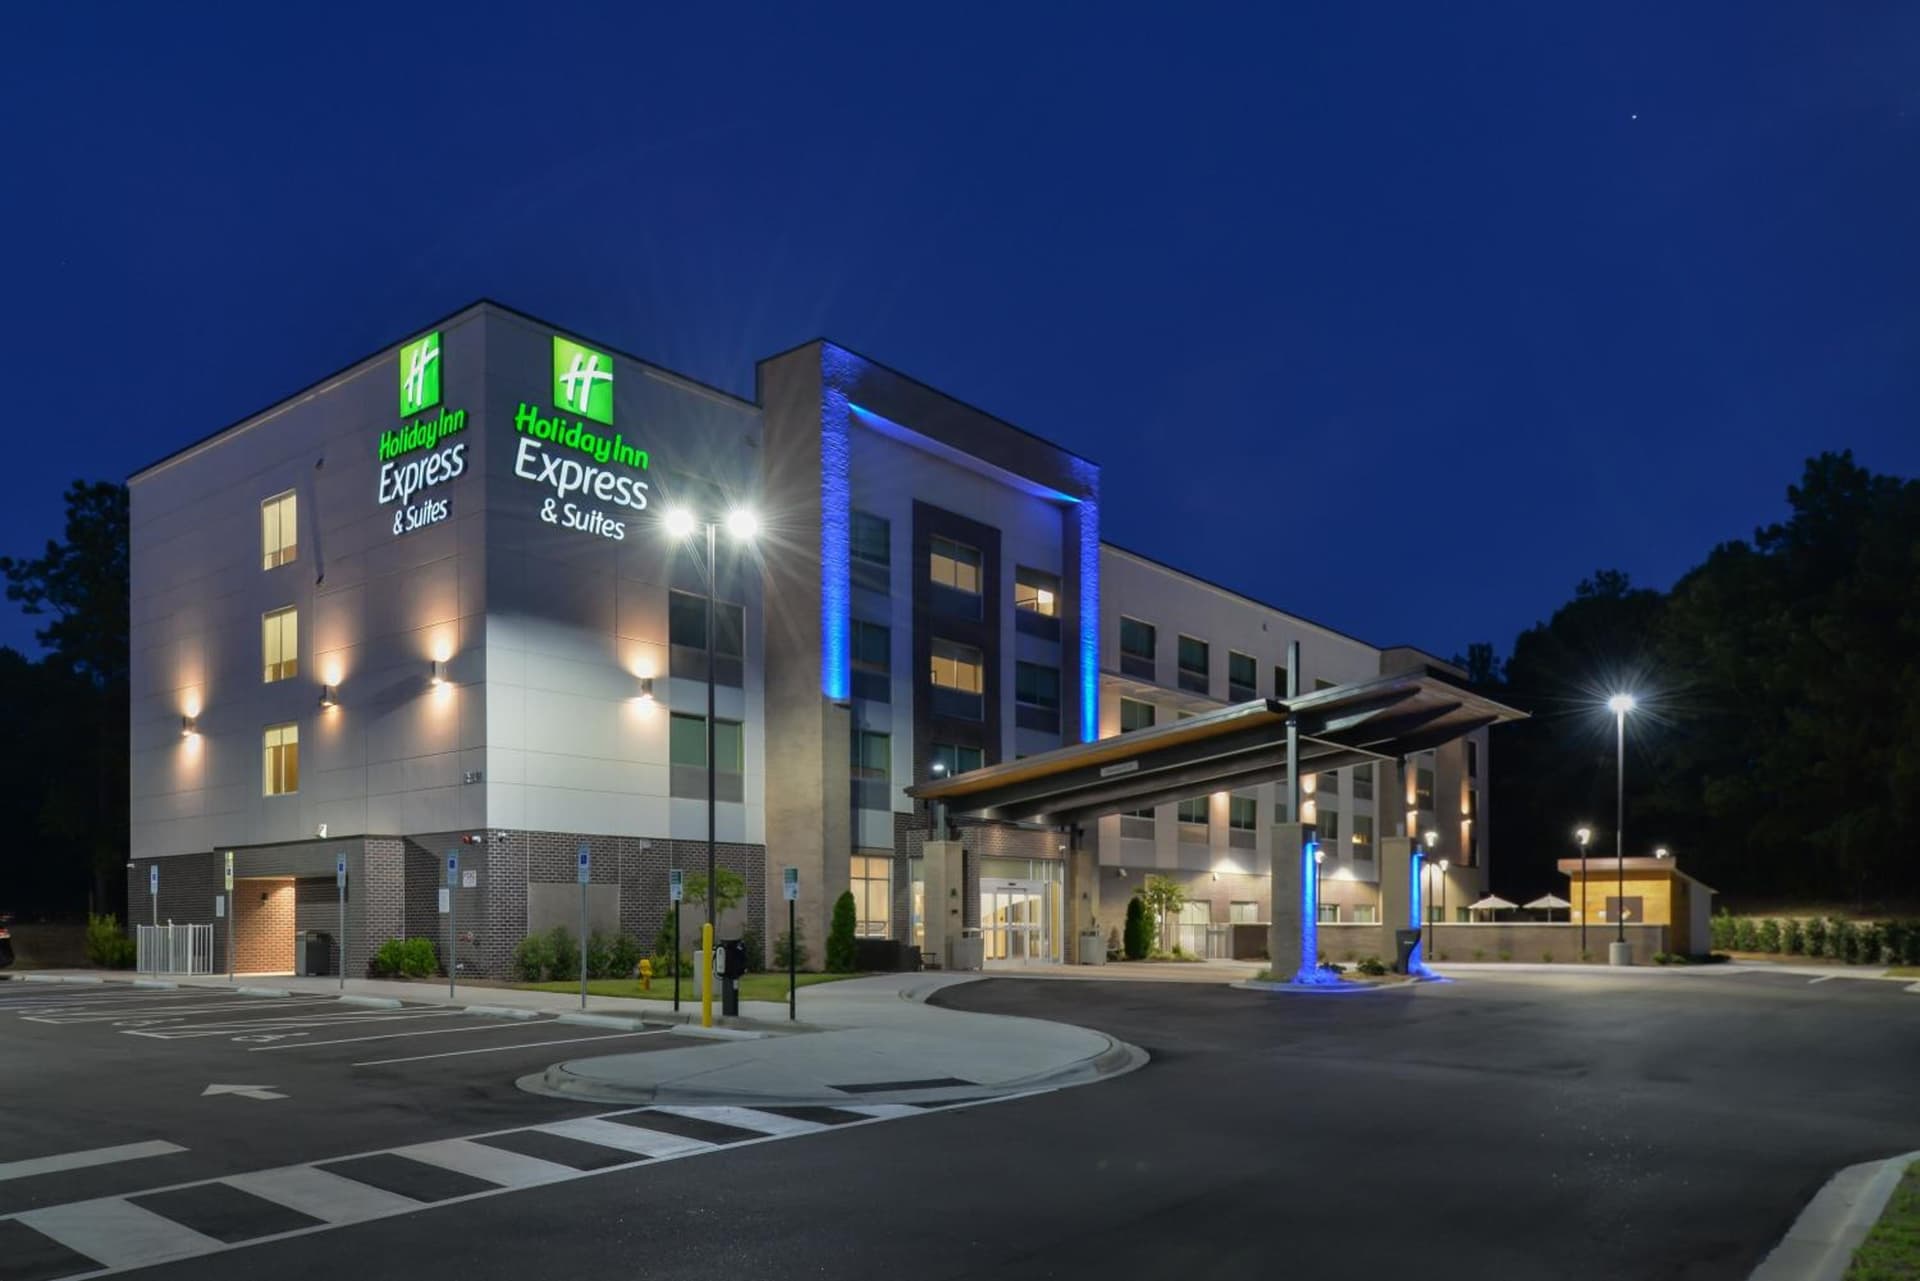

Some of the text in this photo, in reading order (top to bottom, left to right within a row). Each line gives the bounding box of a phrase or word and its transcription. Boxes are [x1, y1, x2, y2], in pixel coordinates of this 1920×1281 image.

[379, 408, 465, 460] Holiday Inn
[515, 402, 649, 470] Holiday Inn
[378, 444, 465, 505] Express
[515, 437, 649, 510] Express
[392, 499, 448, 535] & Suites
[540, 498, 625, 540] & Suites
